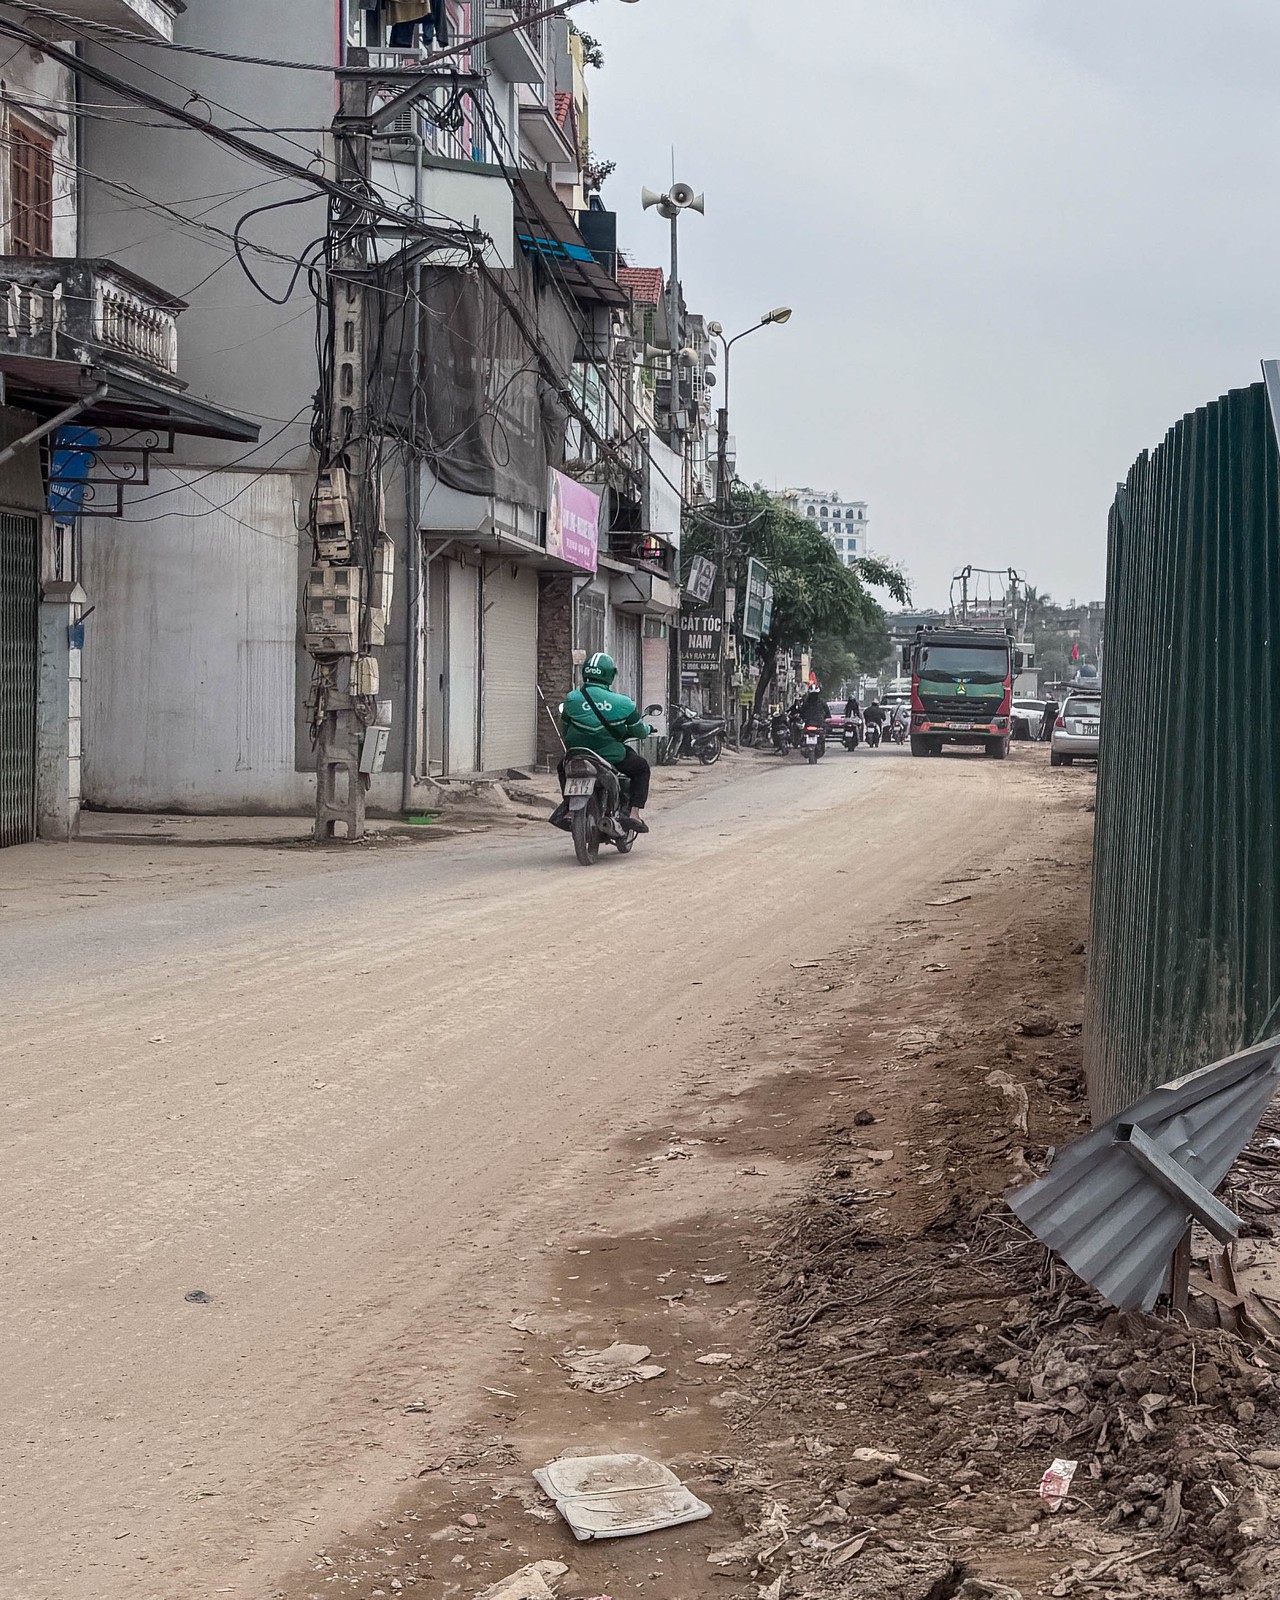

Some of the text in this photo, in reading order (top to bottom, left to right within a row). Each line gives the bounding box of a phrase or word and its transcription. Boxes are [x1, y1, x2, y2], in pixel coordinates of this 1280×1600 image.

[702, 614, 721, 632] TÓC
[688, 634, 712, 649] NAM
[584, 666, 602, 675] Grab
[582, 701, 613, 712] Gab
